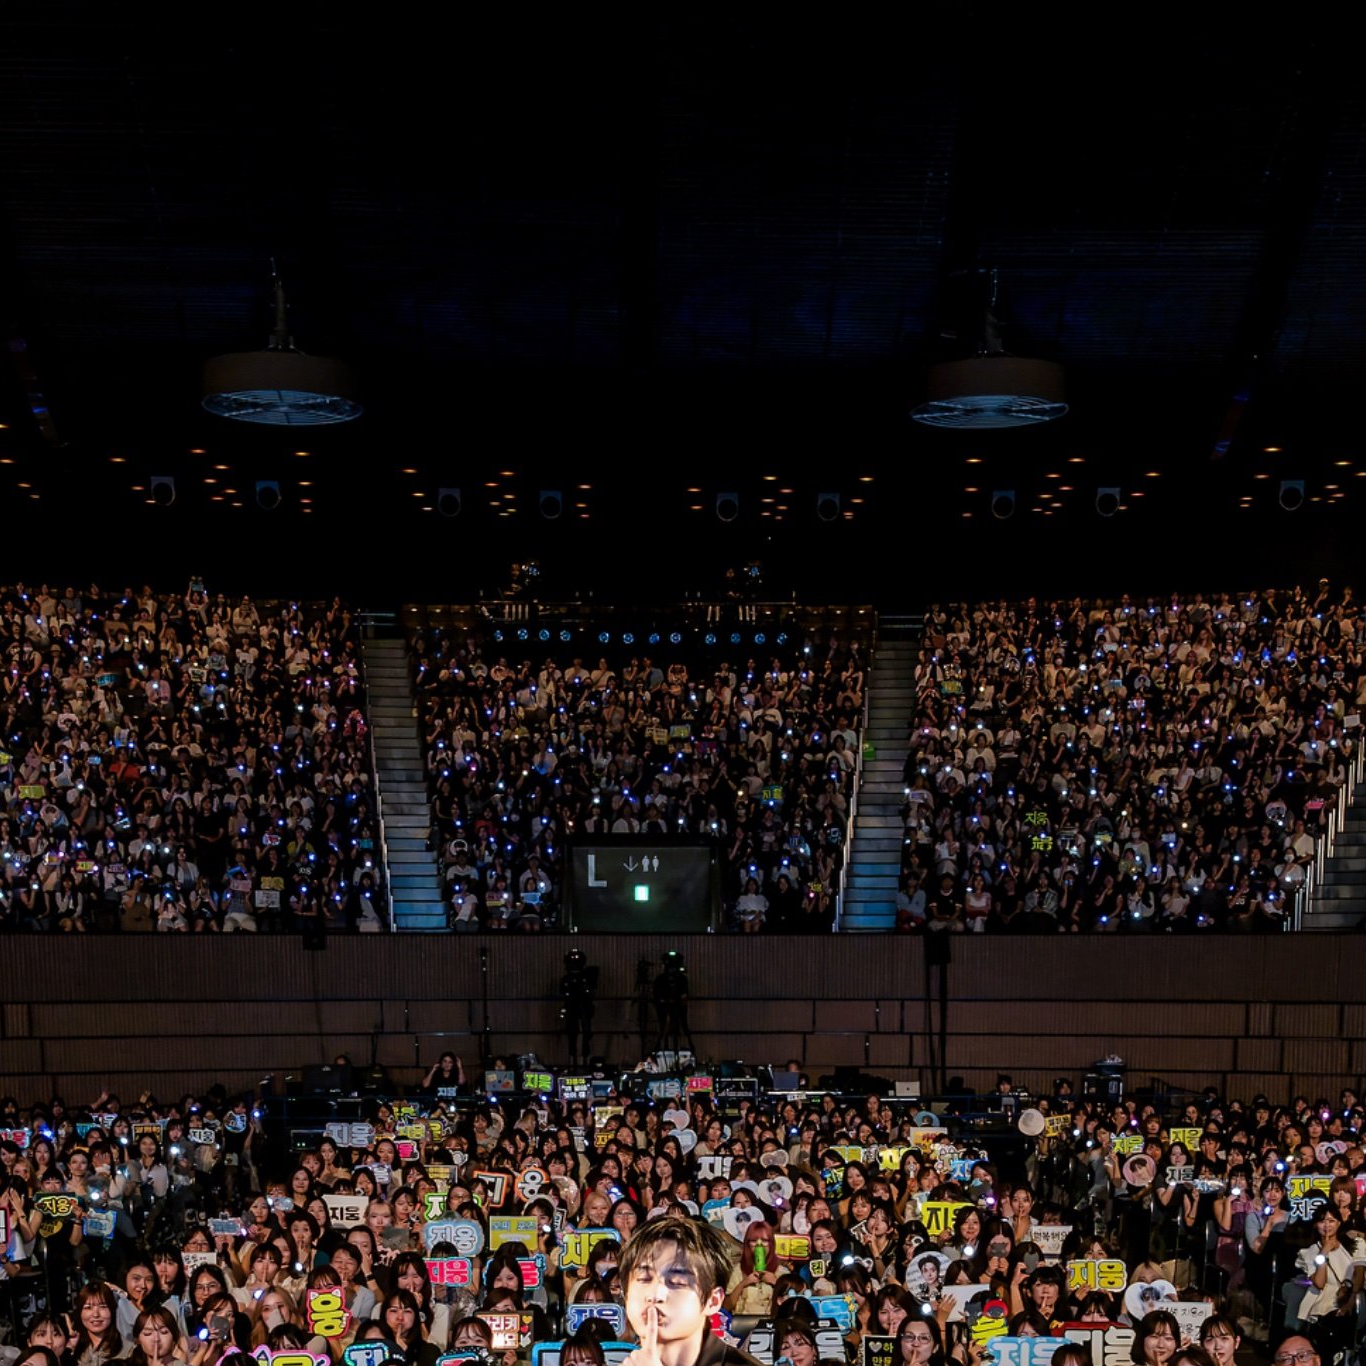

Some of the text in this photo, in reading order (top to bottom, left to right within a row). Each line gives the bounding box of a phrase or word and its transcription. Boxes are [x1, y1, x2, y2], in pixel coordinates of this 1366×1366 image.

[588, 855, 607, 887] L
[330, 1206, 360, 1223] 지웅
[430, 1224, 477, 1250] 지웅
[1067, 1259, 1128, 1291] 지웅
